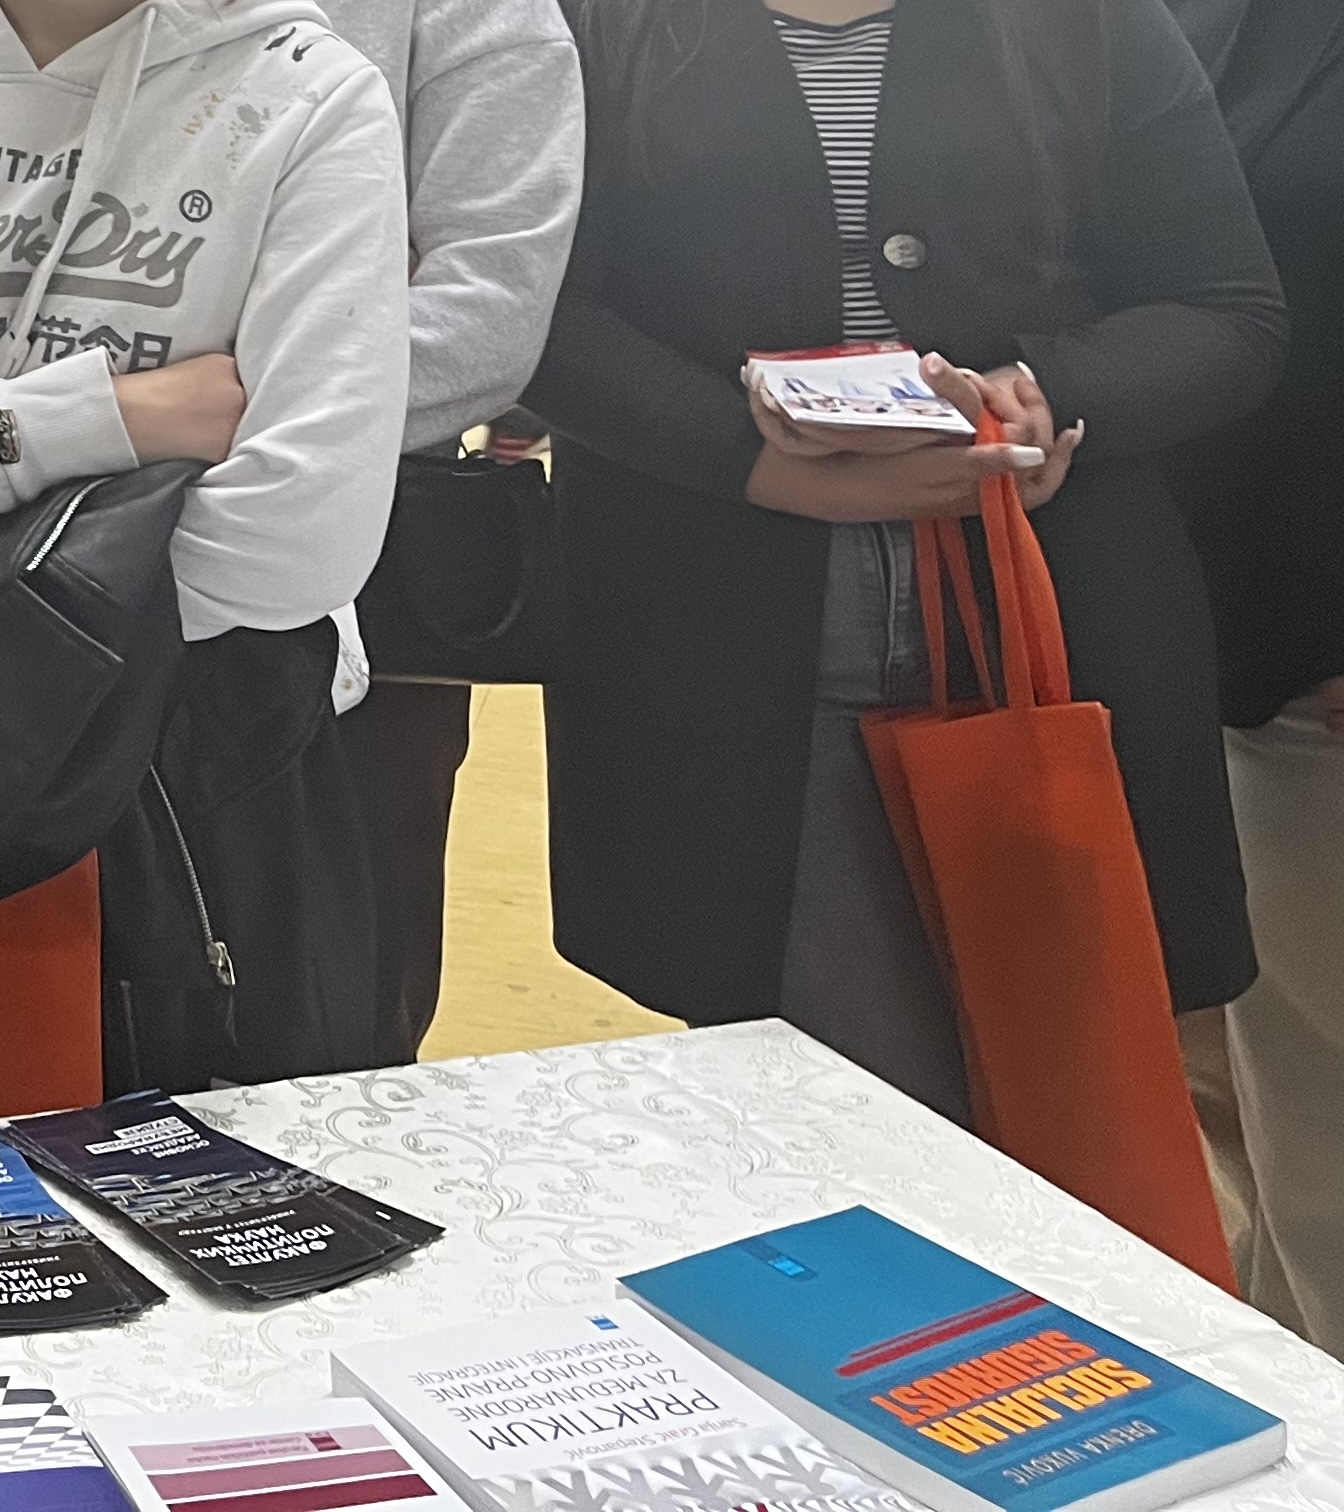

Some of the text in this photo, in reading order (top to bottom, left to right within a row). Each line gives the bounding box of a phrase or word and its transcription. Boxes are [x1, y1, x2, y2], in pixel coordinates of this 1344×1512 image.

[189, 1224, 334, 1258] ПОЛИТИЧКИХ
[213, 1224, 285, 1244] НАУКА
[224, 1241, 327, 1266] ФАКУЛТЕТ
[408, 1359, 519, 1386] INTEGRACIJE
[525, 1337, 644, 1366] TRANSAKCIJE
[424, 1351, 662, 1403] POSLOVNO-PRAVNE
[447, 1369, 688, 1422] ZA MEĐUNARODNE
[870, 1329, 1096, 1426] SIGURNOST
[468, 1389, 720, 1451] PRAKTIKUM
[916, 1358, 1152, 1455] SOCIJALNA
